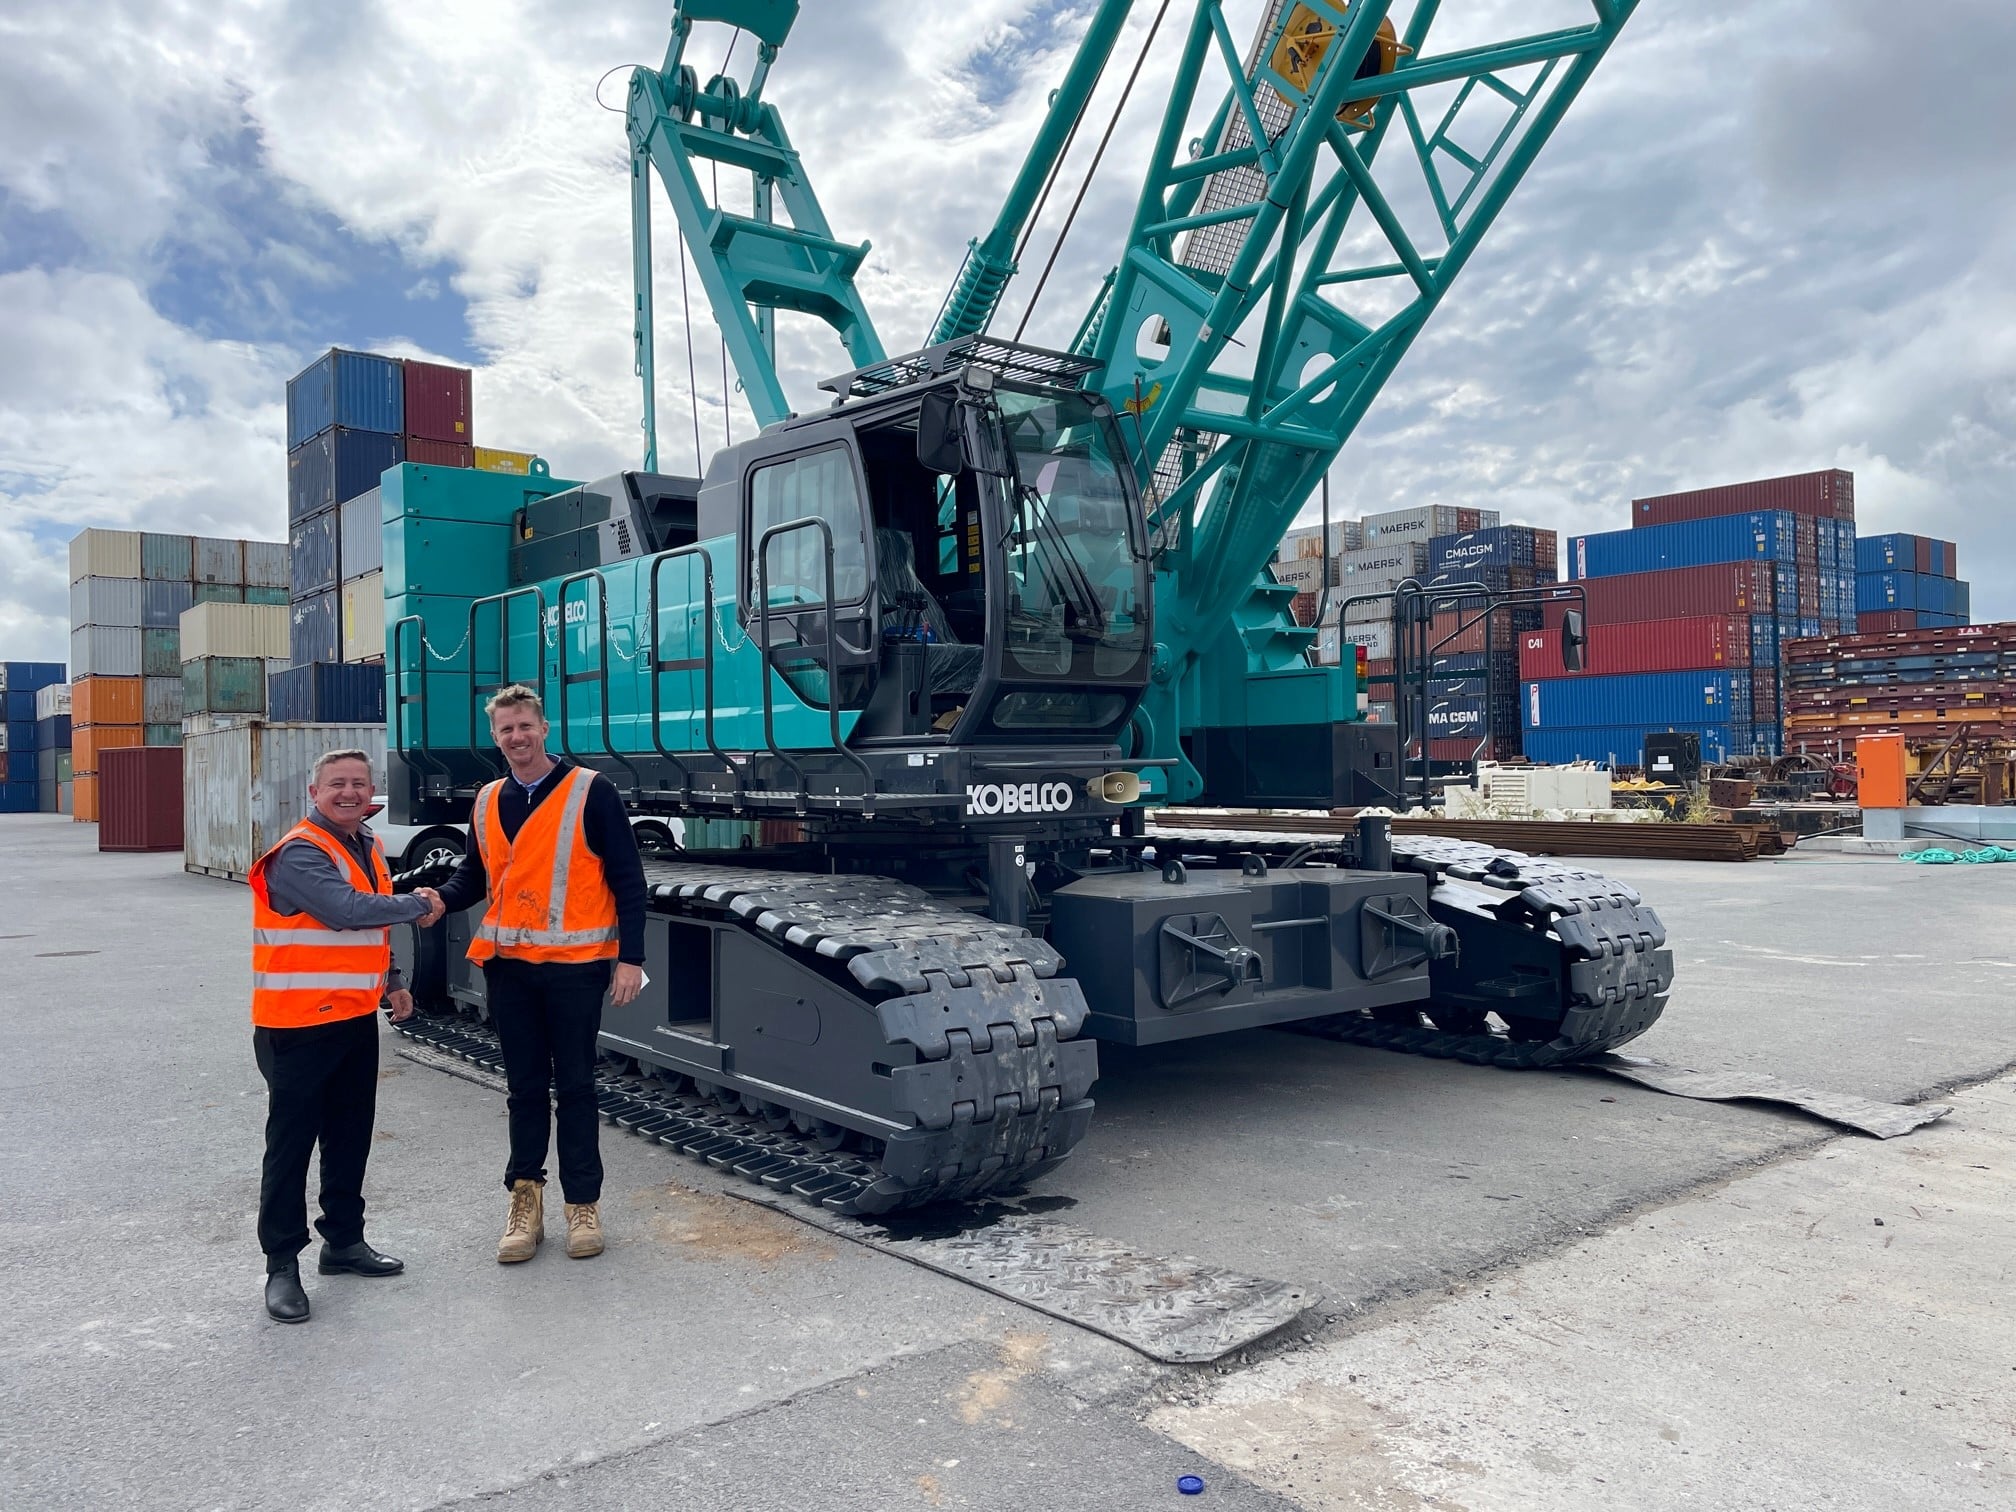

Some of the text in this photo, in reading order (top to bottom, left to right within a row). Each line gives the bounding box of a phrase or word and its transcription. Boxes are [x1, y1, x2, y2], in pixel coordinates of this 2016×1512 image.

[1380, 520, 1425, 535] MAERSK
[1445, 543, 1493, 559] CMA CGM
[1359, 557, 1402, 571] MAERSK
[1277, 571, 1311, 583] AERSK
[547, 599, 586, 627] KOELCO
[1958, 626, 1983, 635] TAL
[1344, 633, 1377, 643] AERSK
[1428, 711, 1478, 725] MA CGM
[966, 782, 1073, 815] KOBELCO
